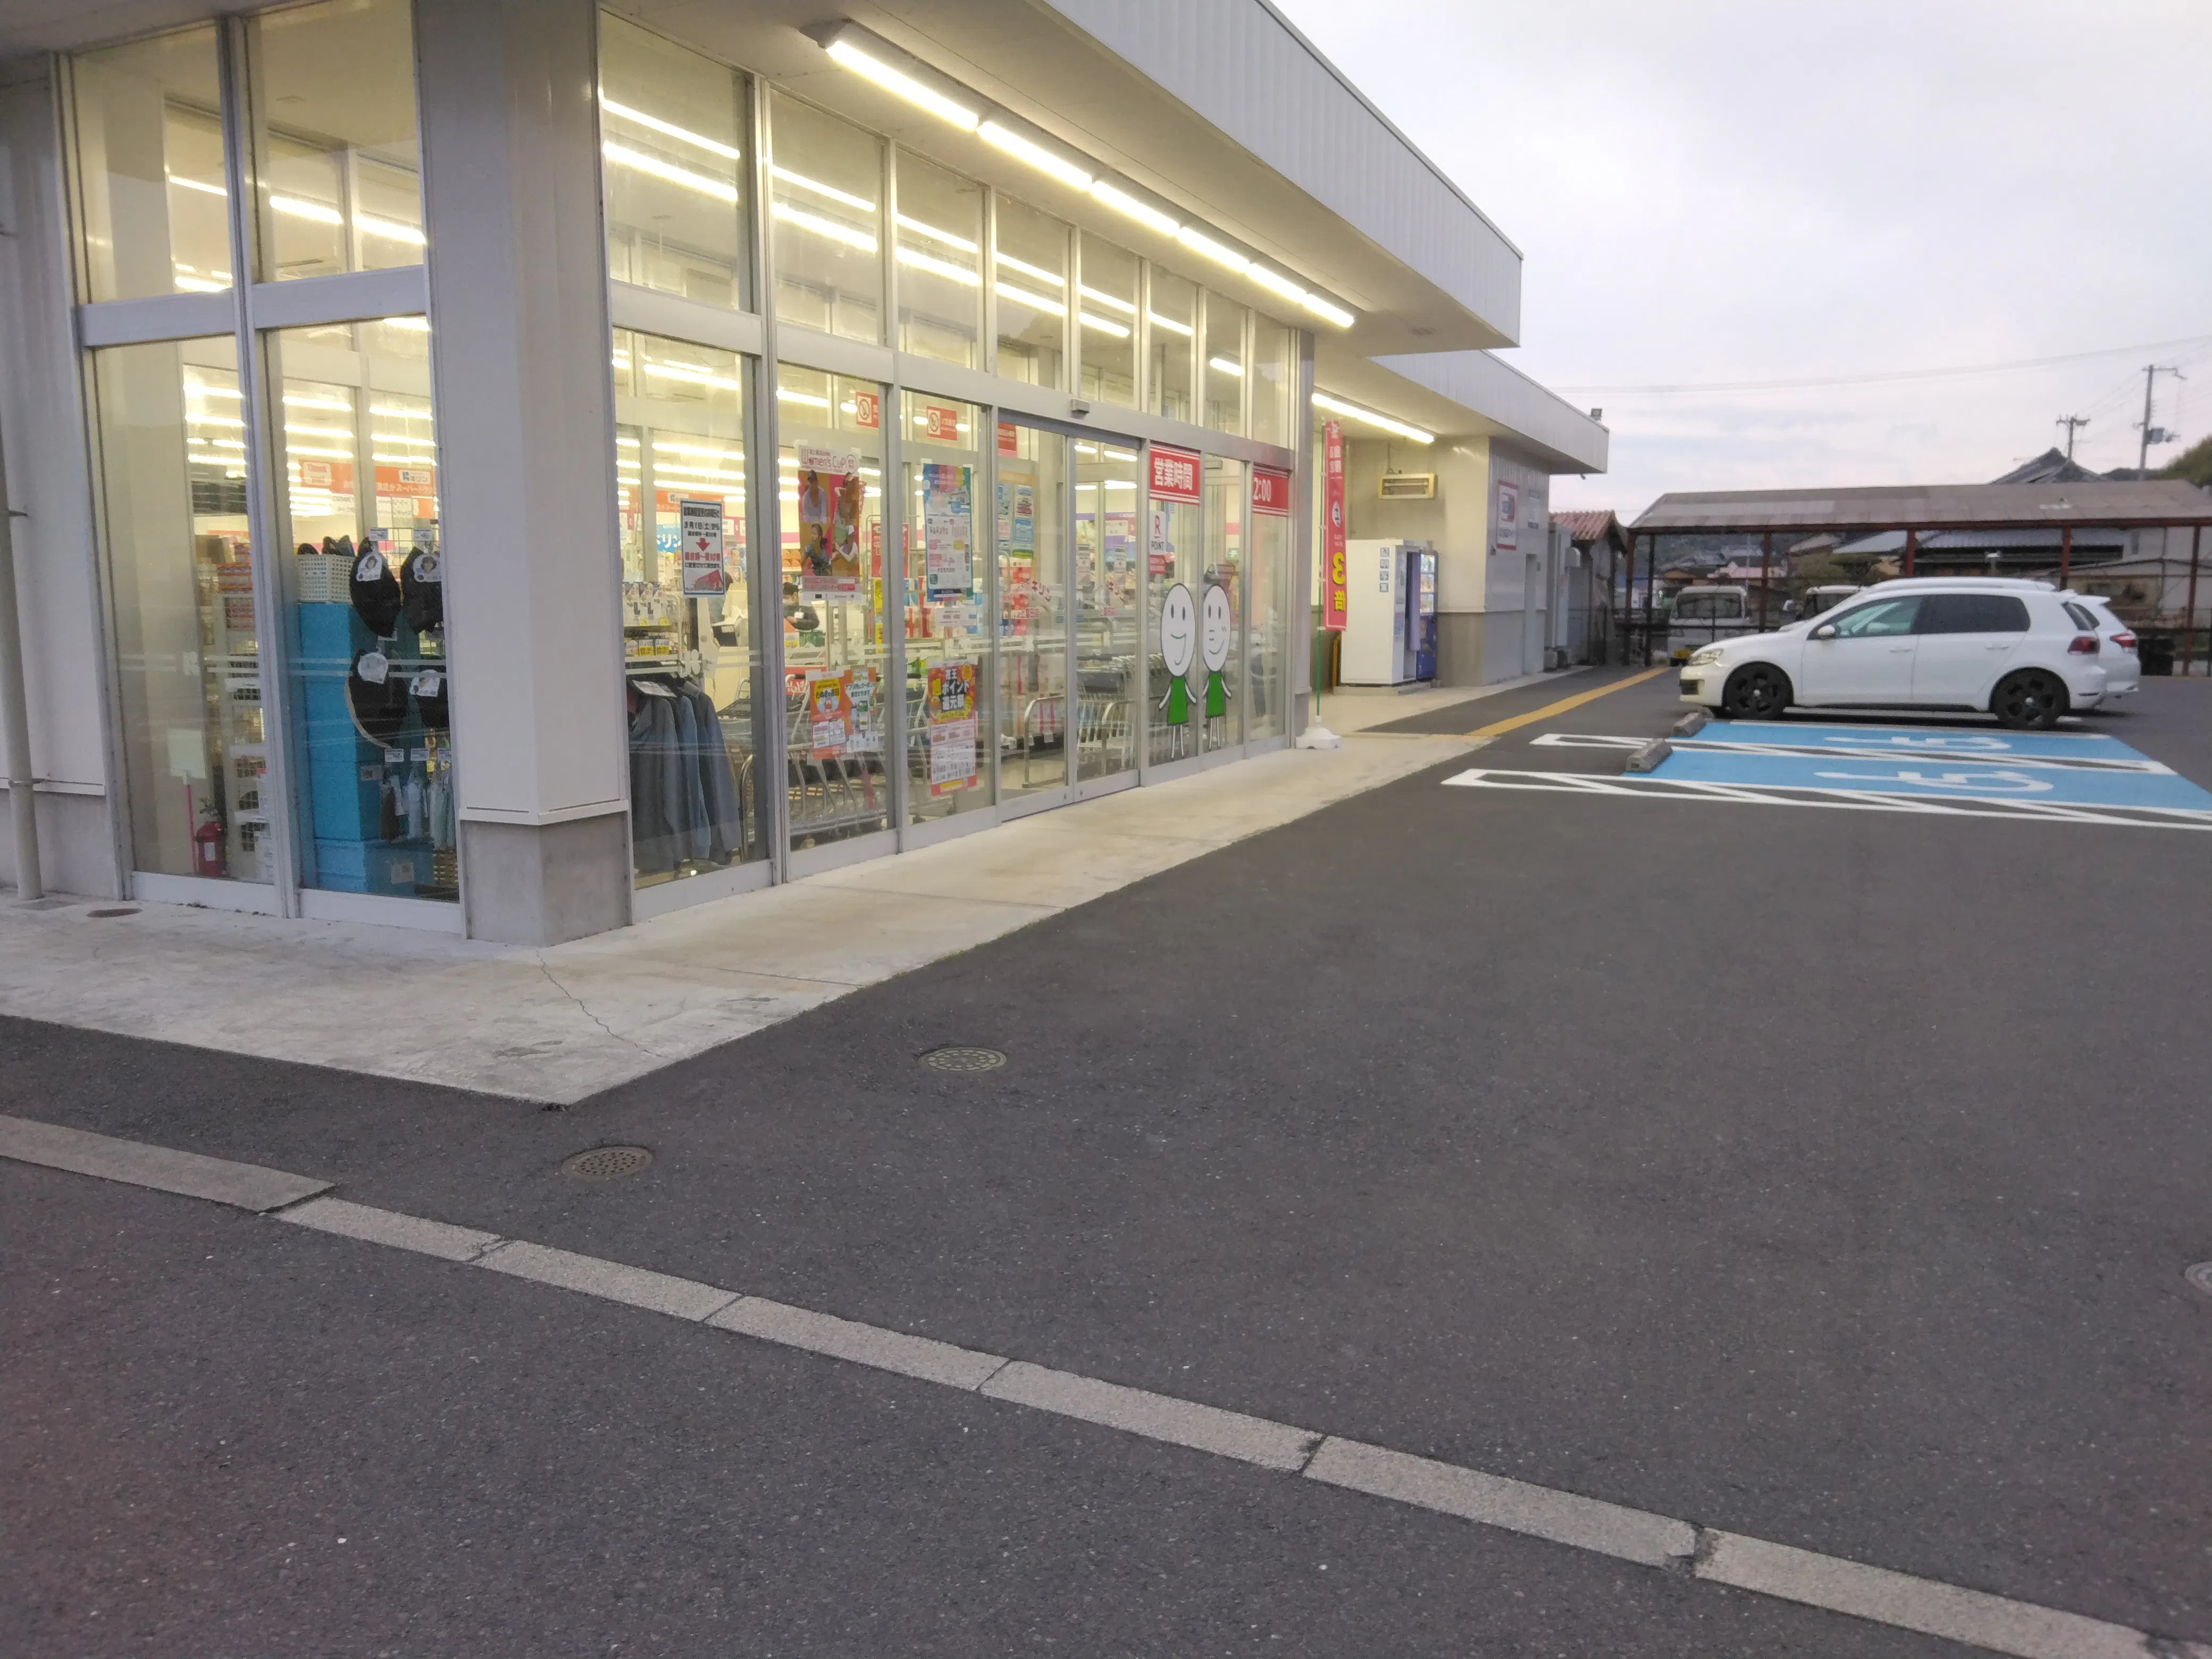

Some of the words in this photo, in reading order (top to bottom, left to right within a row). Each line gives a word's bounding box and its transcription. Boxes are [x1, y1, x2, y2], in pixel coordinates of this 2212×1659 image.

[1154, 457, 1193, 491] 営業時間
[1151, 540, 1164, 550] POINT
[942, 680, 970, 696] ポイント
